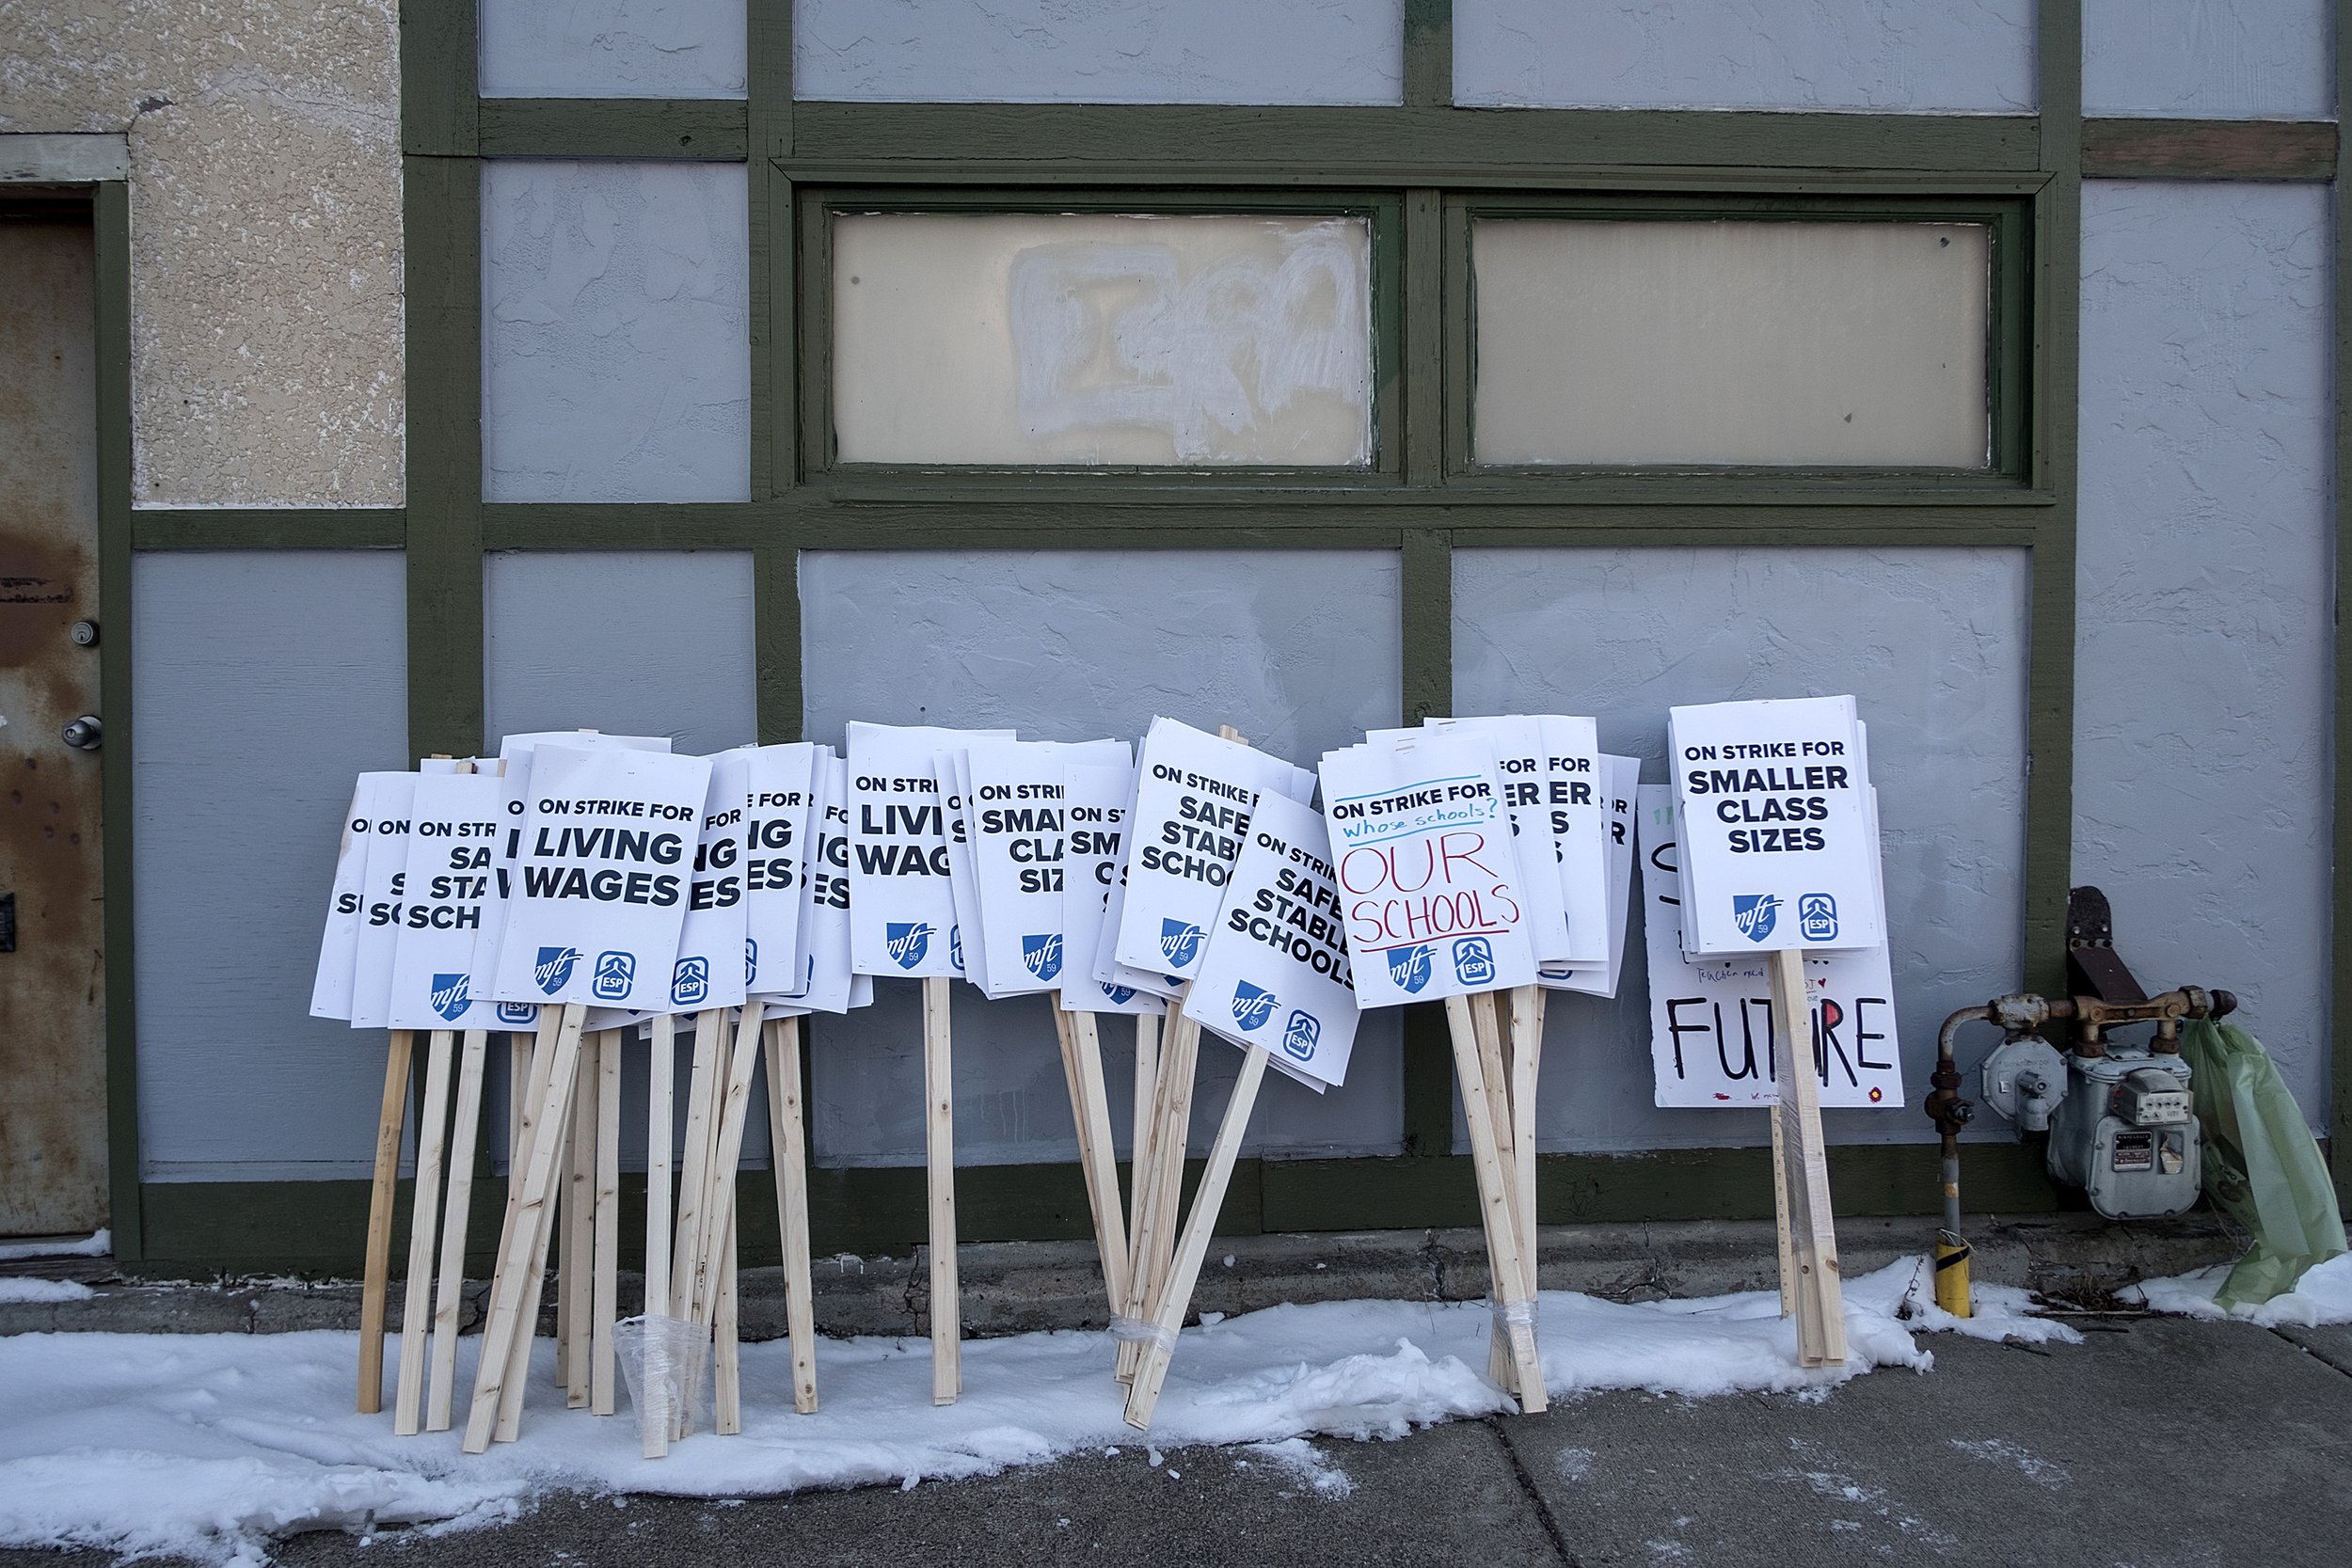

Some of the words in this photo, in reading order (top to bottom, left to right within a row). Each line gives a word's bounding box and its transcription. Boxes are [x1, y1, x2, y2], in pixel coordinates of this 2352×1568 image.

[1685, 746, 1717, 761] ON
[1723, 742, 1796, 759] STRIKE
[1802, 741, 1845, 756] FOR
[1549, 757, 1590, 772] FOR
[855, 776, 886, 791] ON
[1152, 764, 1182, 784] ON
[1186, 773, 1248, 804] STRIKE
[1688, 766, 1849, 794] SMALLER
[758, 792, 801, 807] FOR
[979, 785, 1011, 800] ON
[1017, 784, 1064, 800] STRI
[1332, 803, 1364, 819] ON
[1370, 788, 1443, 815] STRIKE
[1448, 783, 1491, 800] FOR
[539, 799, 570, 815] ON
[574, 800, 644, 816] STRIKE
[649, 803, 693, 821] FOR
[706, 809, 741, 831] FOR
[981, 809, 1063, 833] SMA
[1071, 807, 1102, 822] ON
[1179, 796, 1250, 837] SAFE
[1343, 819, 1406, 837] Whose
[1415, 798, 1498, 826] schools?
[1717, 797, 1829, 823] CLASS
[378, 820, 410, 834] ON
[419, 822, 452, 836] ON
[457, 823, 497, 837] STR
[533, 827, 682, 864] LIVING
[1257, 832, 1287, 856] ON
[1728, 827, 1825, 853] SIZES
[1141, 846, 1233, 887] SCHO
[1342, 832, 1498, 894] OUR
[524, 866, 681, 907] WAGES
[1275, 868, 1343, 922] SAFE
[406, 906, 481, 929] SCH
[1352, 884, 1519, 942] SCHOOLS
[1736, 894, 1784, 936] mft
[1810, 919, 1828, 929] ESP
[1758, 924, 1768, 933] 59
[888, 922, 937, 963] mft
[1161, 924, 1207, 959] mft
[909, 952, 919, 961] 59
[1180, 952, 1188, 960] 59
[1391, 944, 1438, 988] mft
[535, 947, 583, 989] mft
[1046, 963, 1057, 973] 59
[1466, 962, 1485, 974] ESP
[553, 977, 563, 987] 59
[603, 976, 623, 988] ESP
[680, 982, 699, 993] ESP
[1414, 975, 1424, 985] 59
[1120, 988, 1131, 996] 59
[453, 1004, 464, 1013] 59
[507, 1002, 528, 1011] ESP
[1232, 991, 1281, 1021] mft
[1248, 1016, 1259, 1026] 59
[1292, 1035, 1308, 1048] ESP
